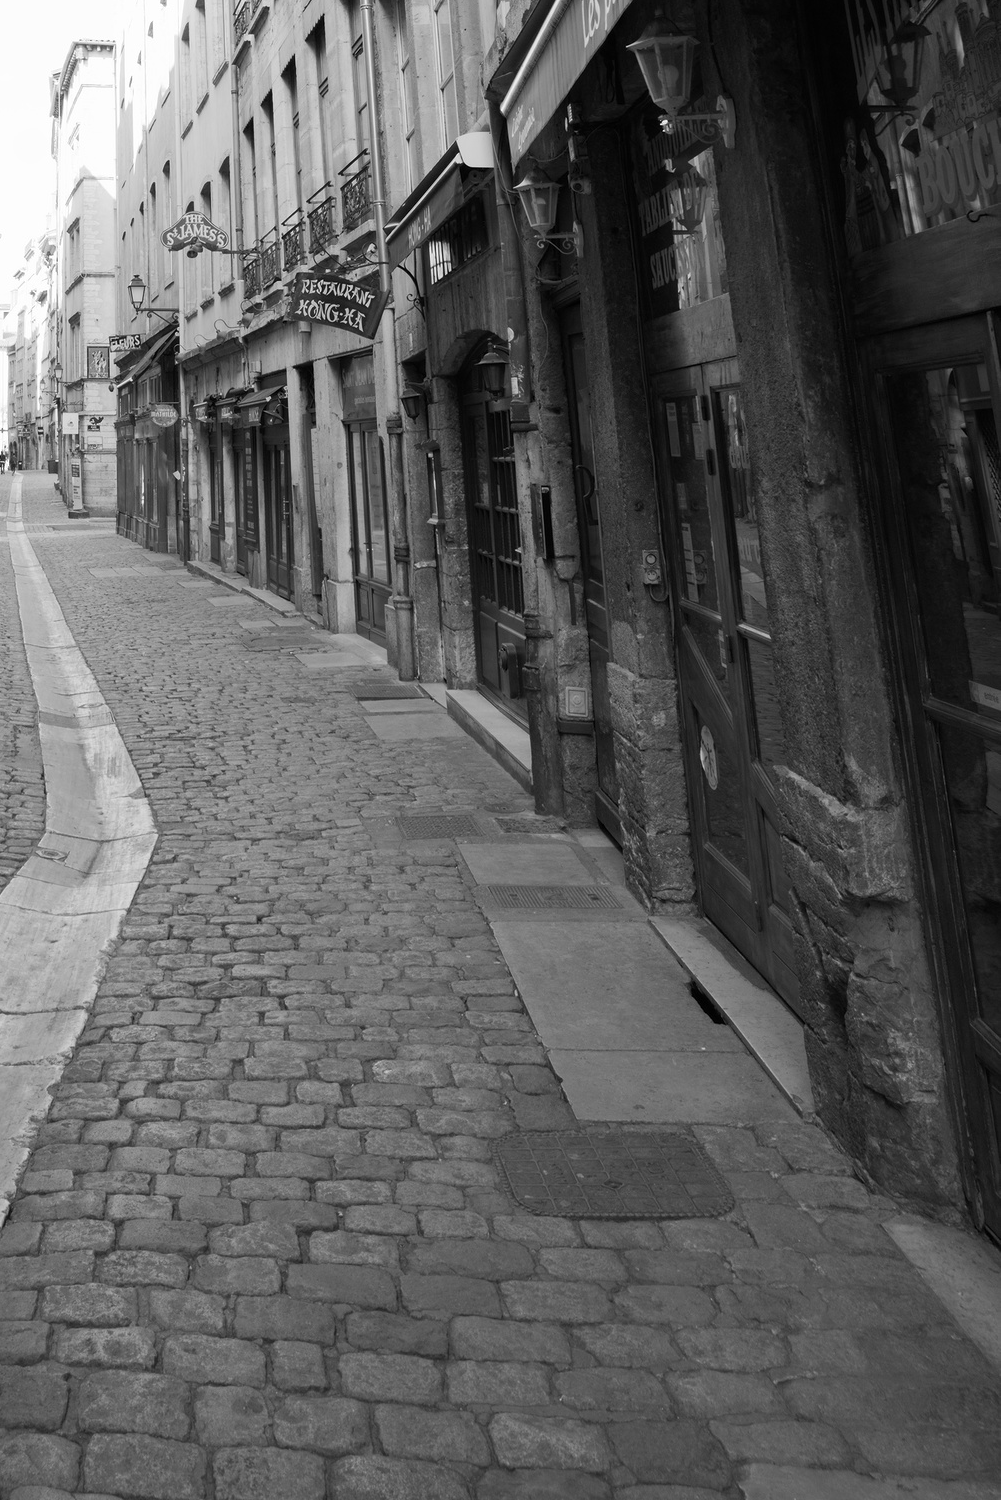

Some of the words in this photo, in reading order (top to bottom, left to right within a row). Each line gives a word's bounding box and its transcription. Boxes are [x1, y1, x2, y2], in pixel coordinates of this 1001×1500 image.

[186, 214, 204, 224] THE
[177, 223, 226, 248] JAMES'S
[301, 279, 375, 309] RESTAURANT
